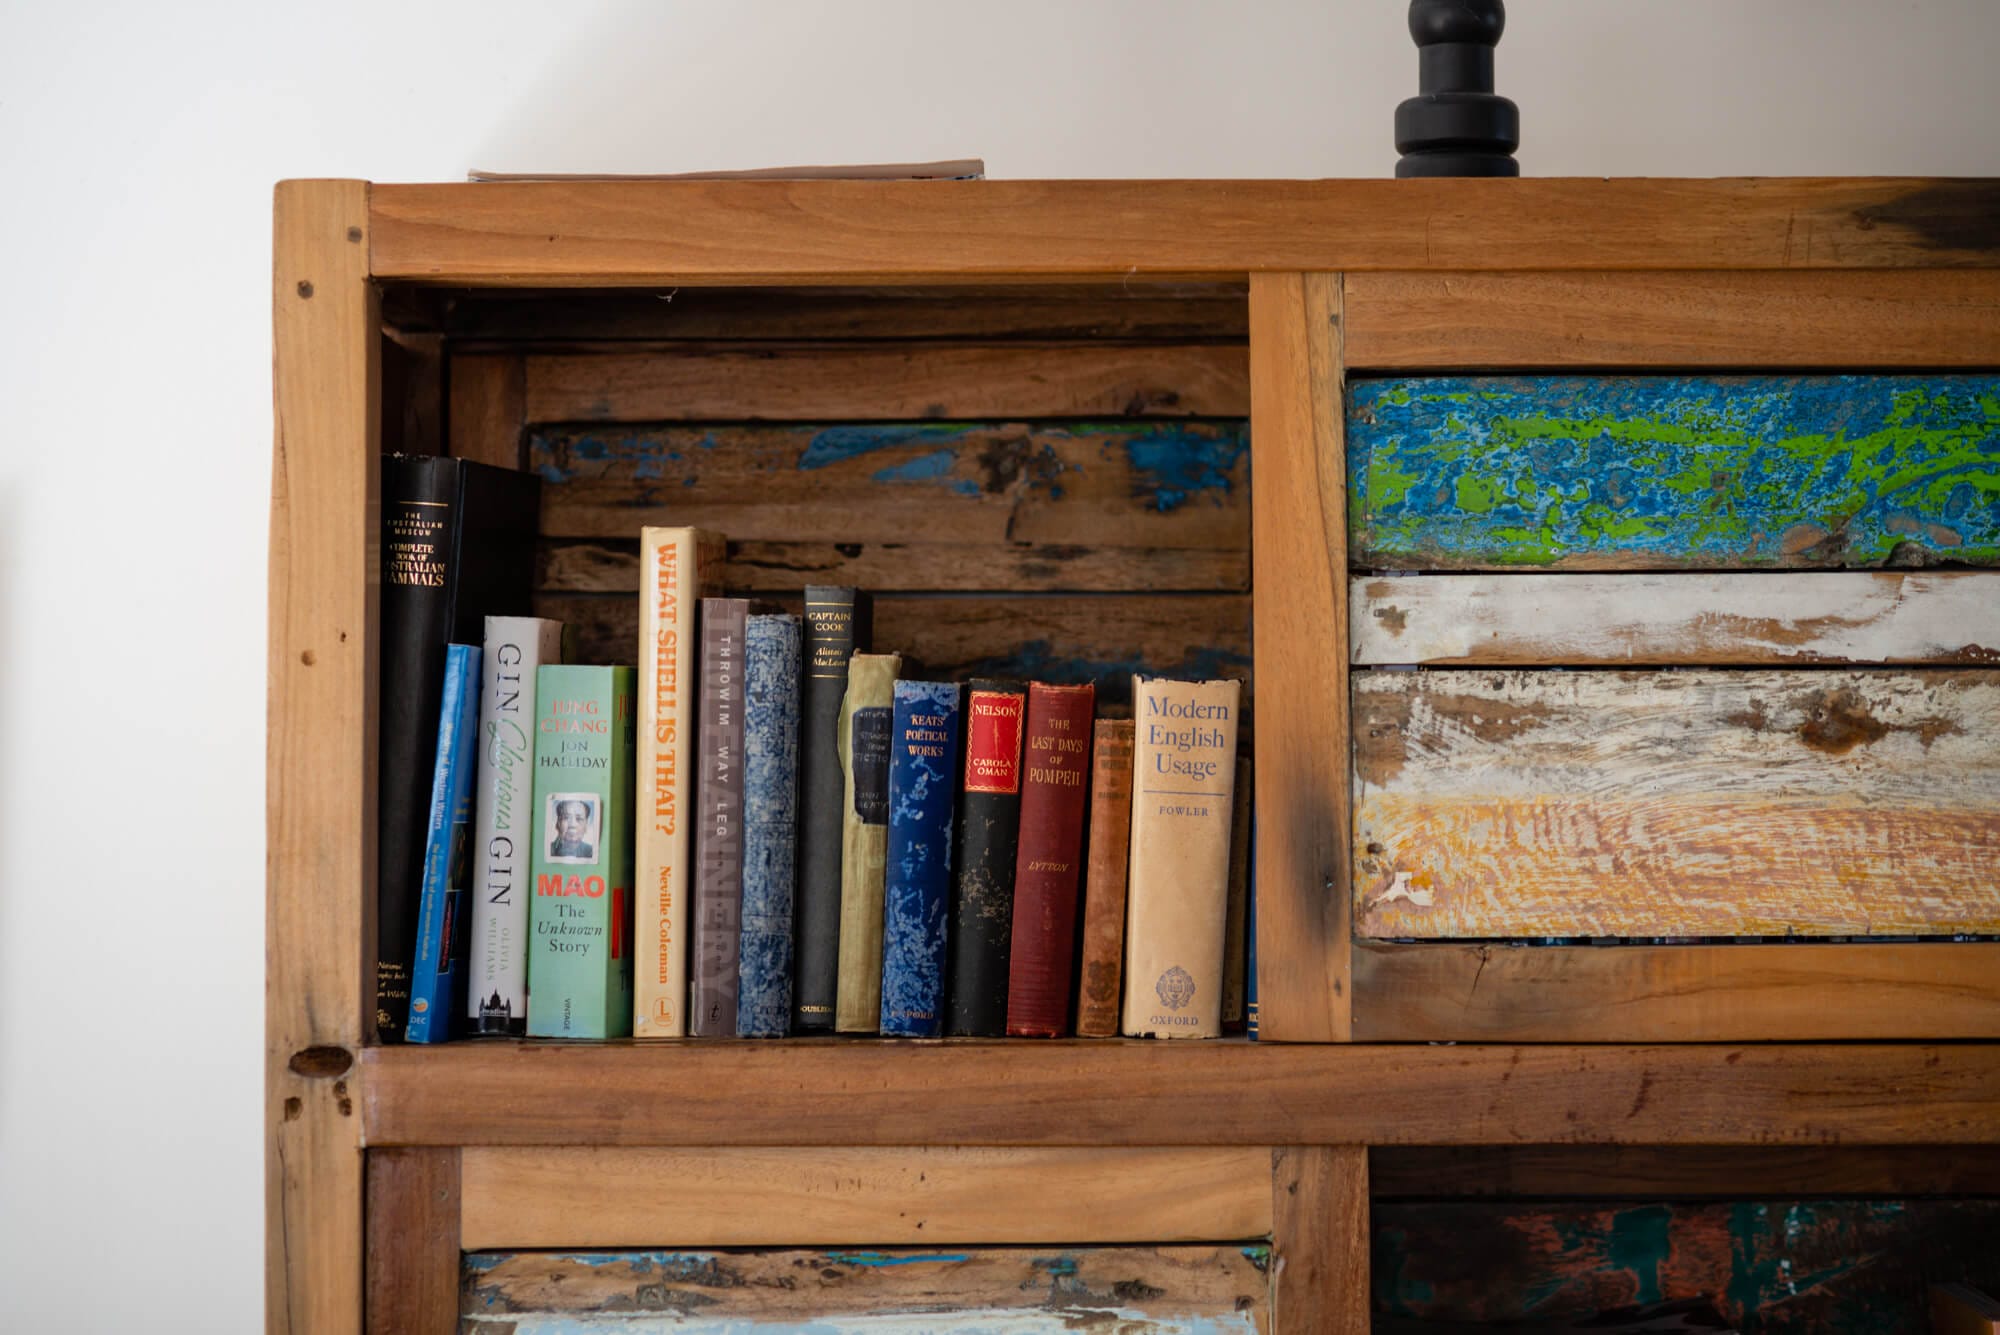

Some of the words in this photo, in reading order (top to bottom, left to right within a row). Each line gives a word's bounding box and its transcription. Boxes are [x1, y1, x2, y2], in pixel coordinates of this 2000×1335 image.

[657, 543, 677, 623] WHAT
[808, 612, 851, 622] CAPTAIN
[815, 623, 844, 632] COOK
[496, 644, 521, 712] GIN
[656, 629, 677, 714] SHELL
[719, 636, 731, 726] THROWIM
[552, 699, 598, 715] JUNG
[975, 704, 1017, 717] NELSON
[1148, 696, 1229, 720] Modern
[541, 719, 608, 734] CHANG
[911, 714, 946, 726] KEATS'
[1048, 719, 1070, 731] THE
[656, 719, 676, 744] IS
[905, 730, 949, 742] POETICAL
[1148, 724, 1225, 752] English
[562, 740, 588, 753] JON
[908, 746, 944, 757] WORKS
[1032, 736, 1055, 751] LAST
[1058, 738, 1084, 754] DAYS
[540, 756, 608, 769] HALLIDAY
[718, 746, 728, 783] WAY
[973, 758, 1012, 769] CAROLA
[1050, 756, 1064, 765] OF
[1156, 753, 1217, 782] Usage
[487, 719, 526, 829] Glorious
[978, 767, 1008, 777] OMAN
[1029, 768, 1080, 786] POMPEII
[656, 750, 676, 836] THAT?
[716, 803, 728, 836] LEG
[1160, 806, 1209, 817] FOWLER
[488, 837, 514, 907] GIN
[1028, 861, 1068, 872] LYTTON
[537, 874, 606, 898] MAO
[659, 866, 672, 915] Neville
[554, 903, 585, 918] The
[537, 920, 602, 936] Unknown
[486, 918, 497, 981] WILLIAMS
[500, 928, 510, 972] OLIVIA
[548, 939, 590, 956] Story
[659, 920, 672, 984] Coleman
[410, 1016, 426, 1024] DEC
[1150, 1016, 1199, 1026] OXFORD
